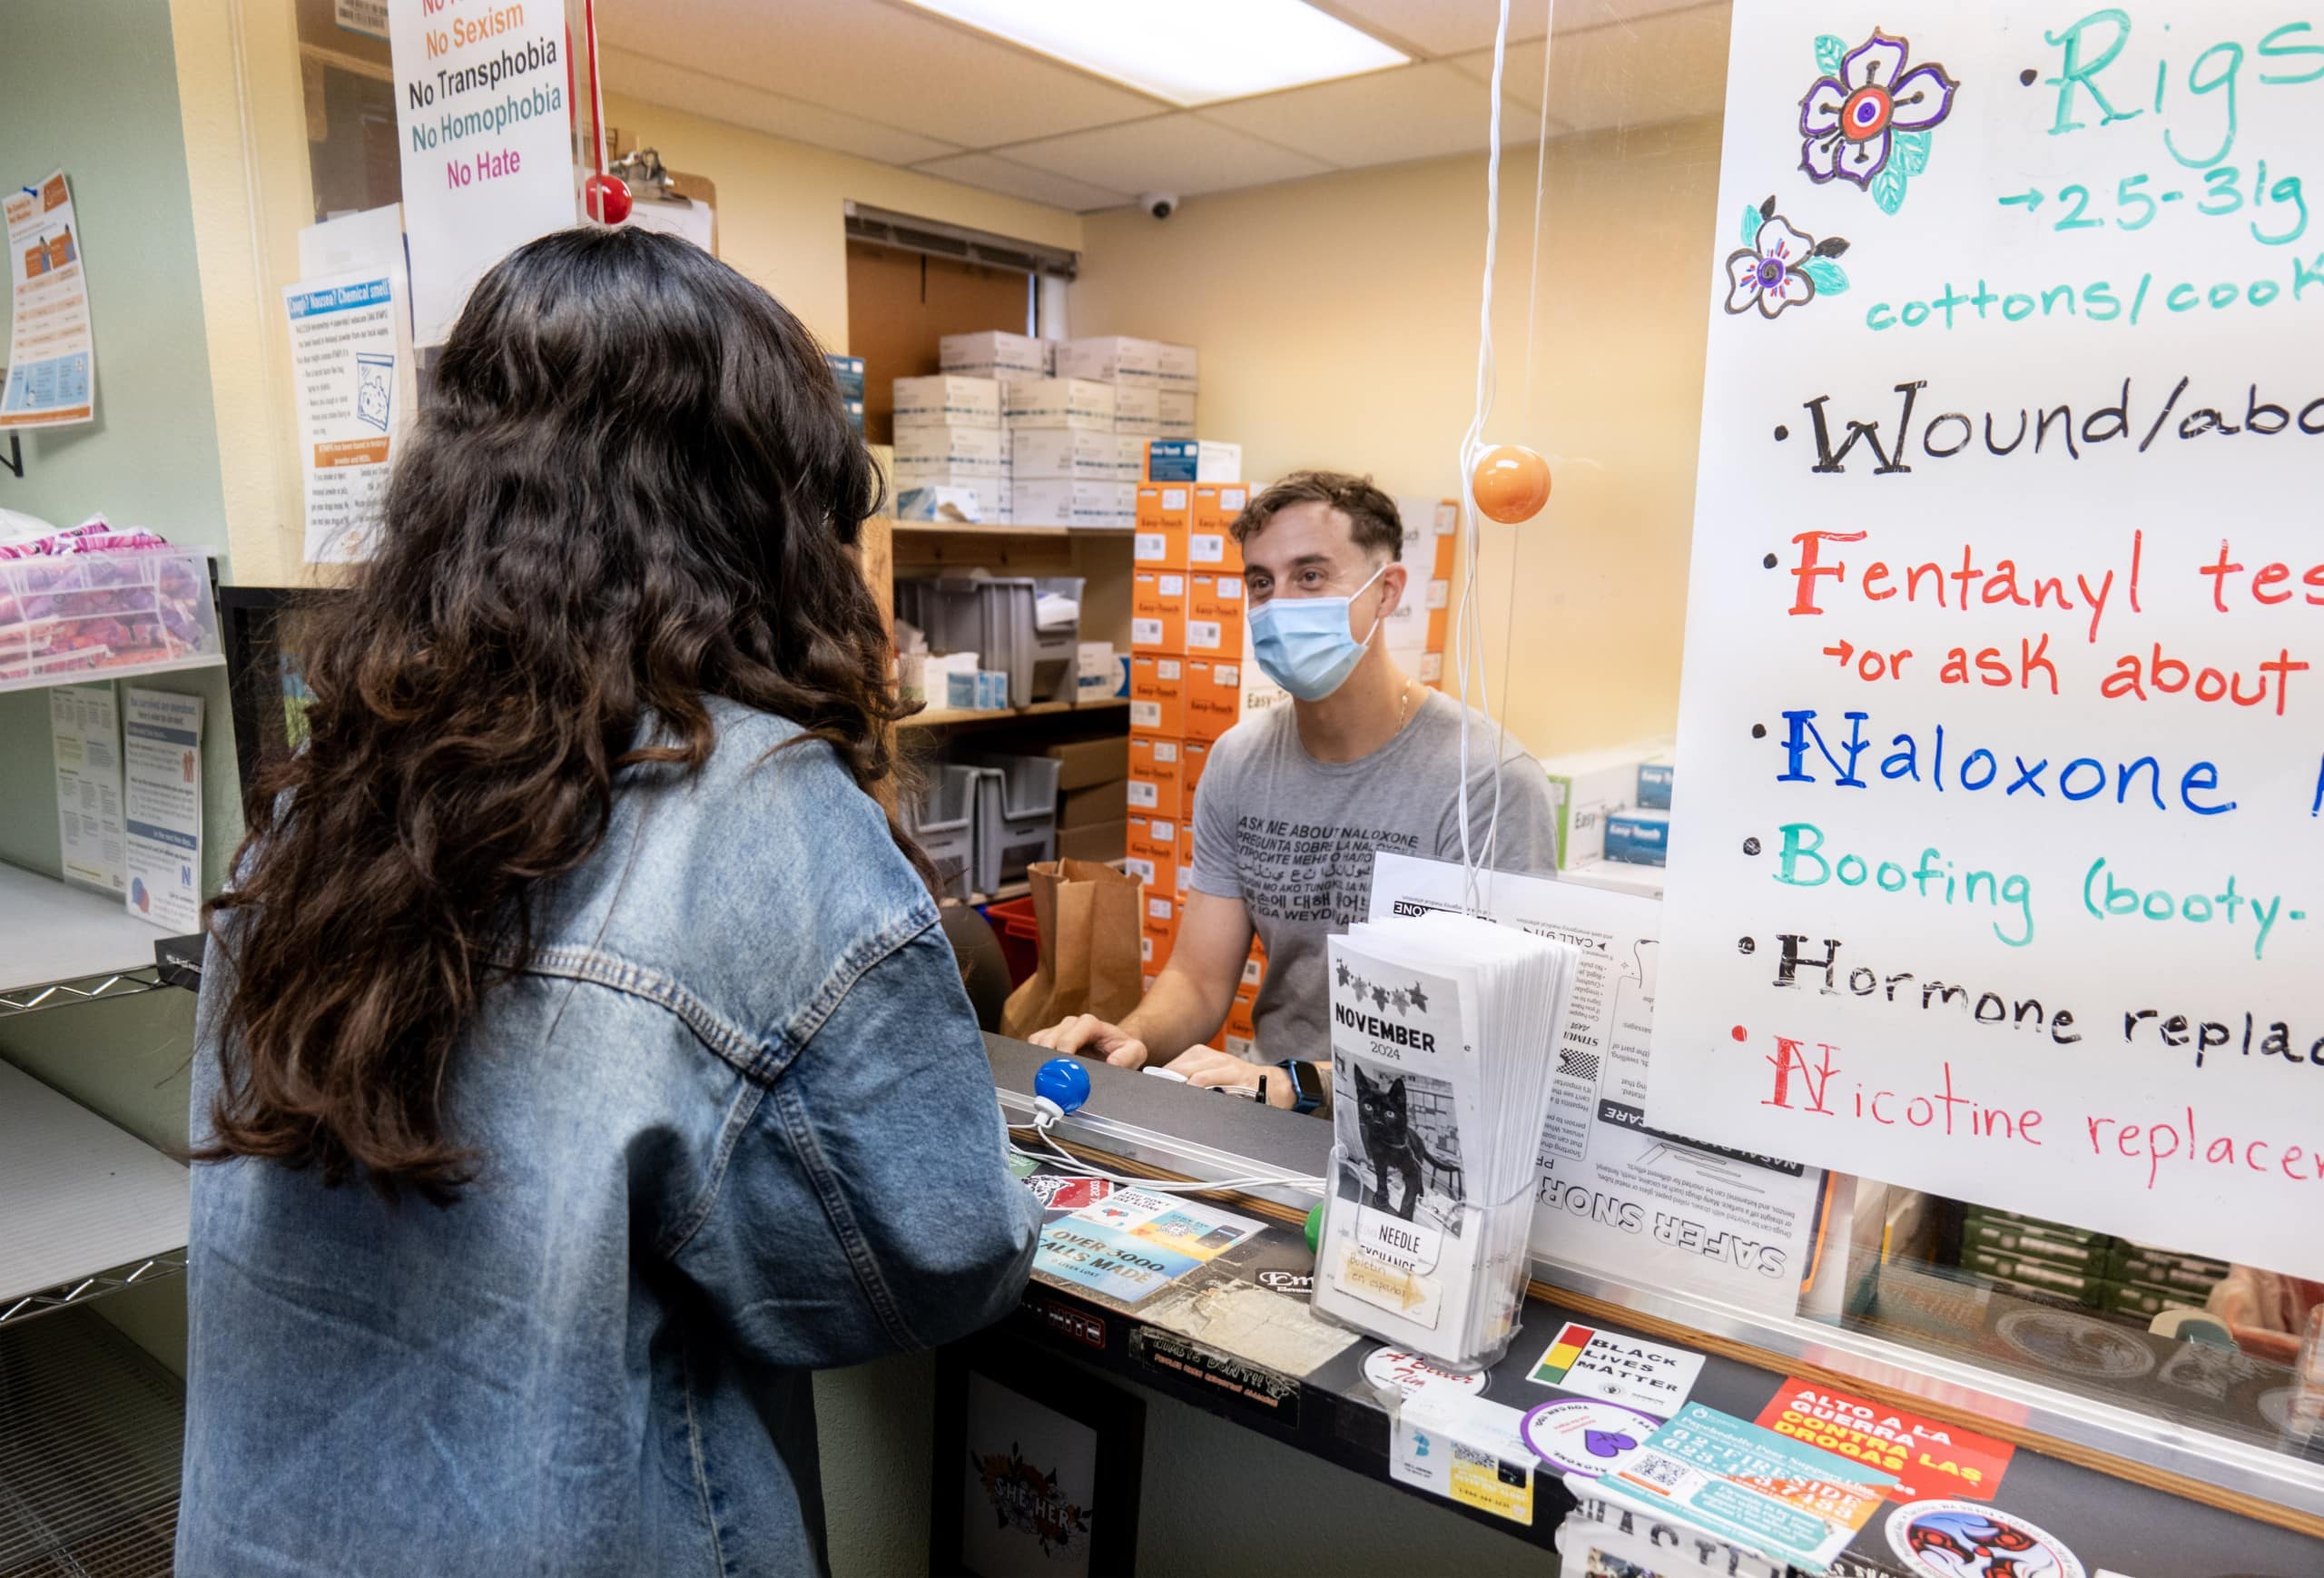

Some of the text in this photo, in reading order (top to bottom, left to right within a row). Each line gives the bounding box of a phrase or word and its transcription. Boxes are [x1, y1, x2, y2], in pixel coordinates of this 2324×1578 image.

[426, 3, 524, 60] No Sexism
[409, 37, 557, 110] No Transphobia
[412, 84, 561, 153] No Homophobia
[448, 147, 520, 190] No Hate
[338, 283, 369, 304] Chemical
[1788, 529, 2142, 643] Fentanyl
[1858, 634, 2309, 715] or ask about
[1777, 710, 2237, 814] Naloxone
[1236, 831, 1350, 853] PREGUNTA SOBRE LA
[1238, 816, 1418, 848] ASK ME ABOUT NALOXONE
[1279, 883, 1301, 893] AKO
[1773, 824, 2034, 947] Boofing
[1516, 918, 1541, 929] attention
[1541, 922, 1561, 932] medical
[1559, 932, 1593, 949] CALL
[1773, 933, 2082, 1045] Hormone
[1335, 1002, 1436, 1054] NOVEMBER
[1589, 1013, 1599, 1021] Can
[1370, 1041, 1401, 1060] 2024
[1574, 1092, 1590, 1101] can't
[1621, 1079, 1635, 1088] that
[1621, 1088, 1645, 1100] ritated.
[1761, 1035, 2043, 1145] Nicotine
[1560, 1100, 1589, 1112] Hepatitis
[1561, 1128, 1584, 1138] viruses.
[1563, 1119, 1586, 1129] person
[1554, 1144, 1581, 1158] Snorting
[1570, 1139, 1582, 1148] that
[1379, 1224, 1421, 1254] NEEDLE
[1534, 1177, 1787, 1279] SAFER SNOR
[1052, 1230, 1165, 1272] OVER 3000
[1089, 1257, 1154, 1284] MADE
[1583, 1349, 1655, 1373] LIVES
[1590, 1338, 1677, 1367] BLACK
[1577, 1360, 1679, 1393] MATTER
[1790, 1400, 1916, 1448] GUERRA
[1797, 1390, 1951, 1445] ALTO A LA
[1773, 1420, 1904, 1471] DROGAS
[1781, 1411, 1984, 1484] CONTRA LAS
